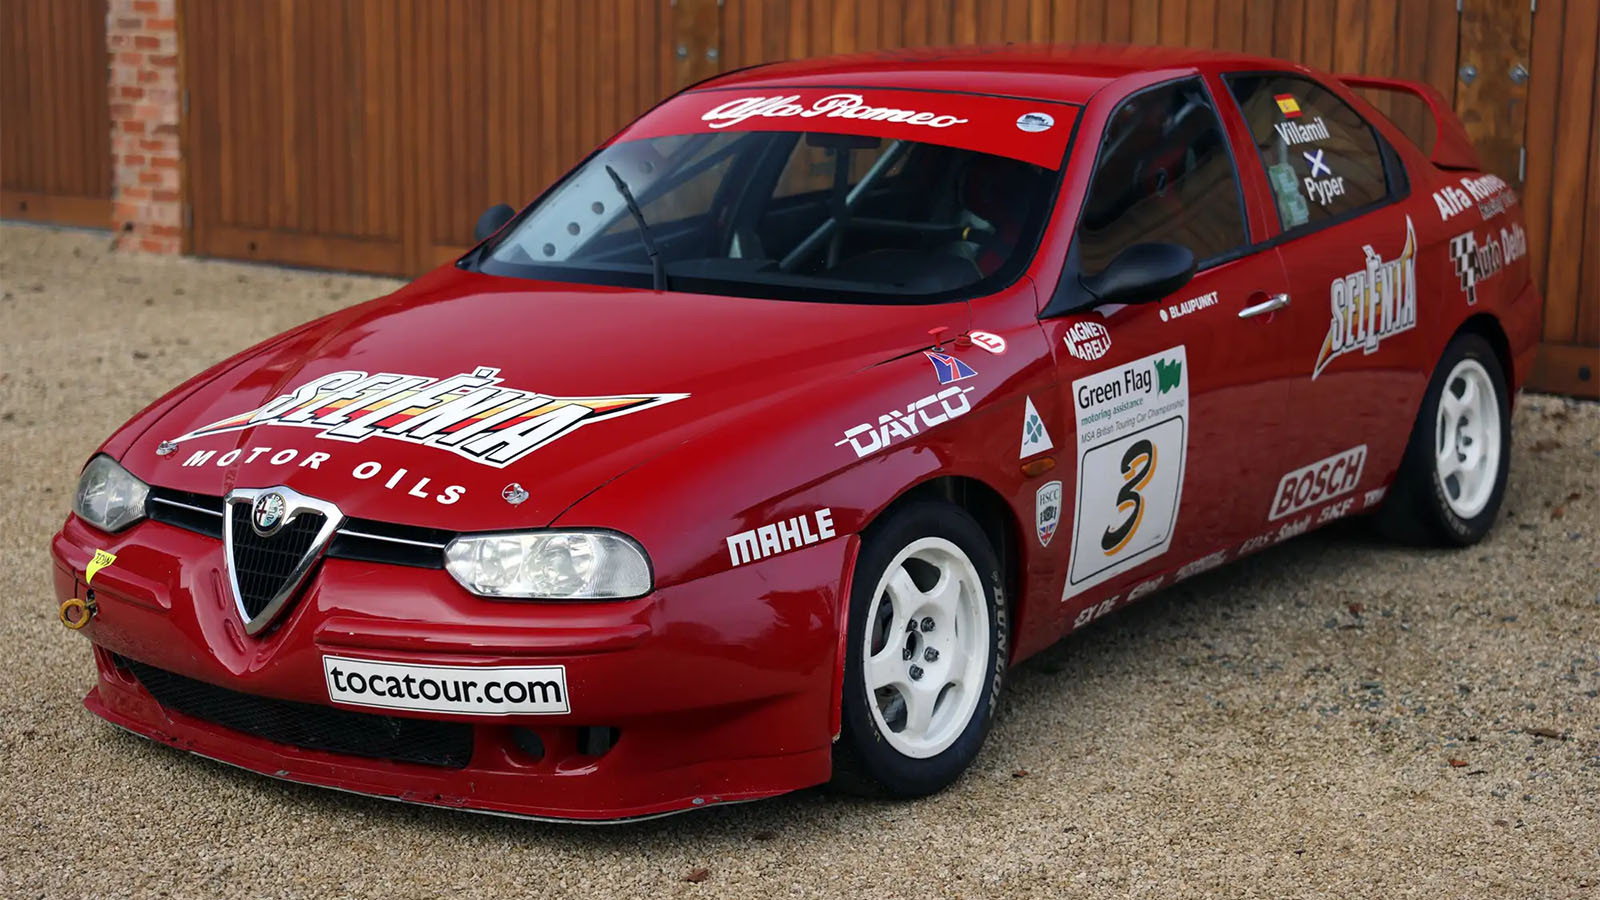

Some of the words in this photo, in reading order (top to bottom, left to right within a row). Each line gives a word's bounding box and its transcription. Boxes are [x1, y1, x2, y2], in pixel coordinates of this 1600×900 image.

[701, 95, 802, 129] Alfa
[801, 93, 968, 128] Romeo
[1274, 116, 1331, 146] Villamil
[1304, 176, 1345, 206] Pyper
[1432, 186, 1473, 221] Alfa
[1169, 291, 1219, 319] BLAUPUNKT
[1078, 379, 1121, 409] Green
[1124, 368, 1152, 394] Flag
[836, 385, 974, 458] DAYCO
[1080, 406, 1112, 426] motoring
[1112, 397, 1144, 415] assistance
[1080, 431, 1096, 443] MSA
[181, 446, 335, 471] MOTOR
[352, 460, 467, 506] OILS
[1277, 450, 1364, 515] BOSCH
[1040, 488, 1059, 506] HSCC
[1101, 439, 1158, 557] 3
[726, 508, 836, 566] MAHLE
[330, 664, 563, 706] tocatour.com
